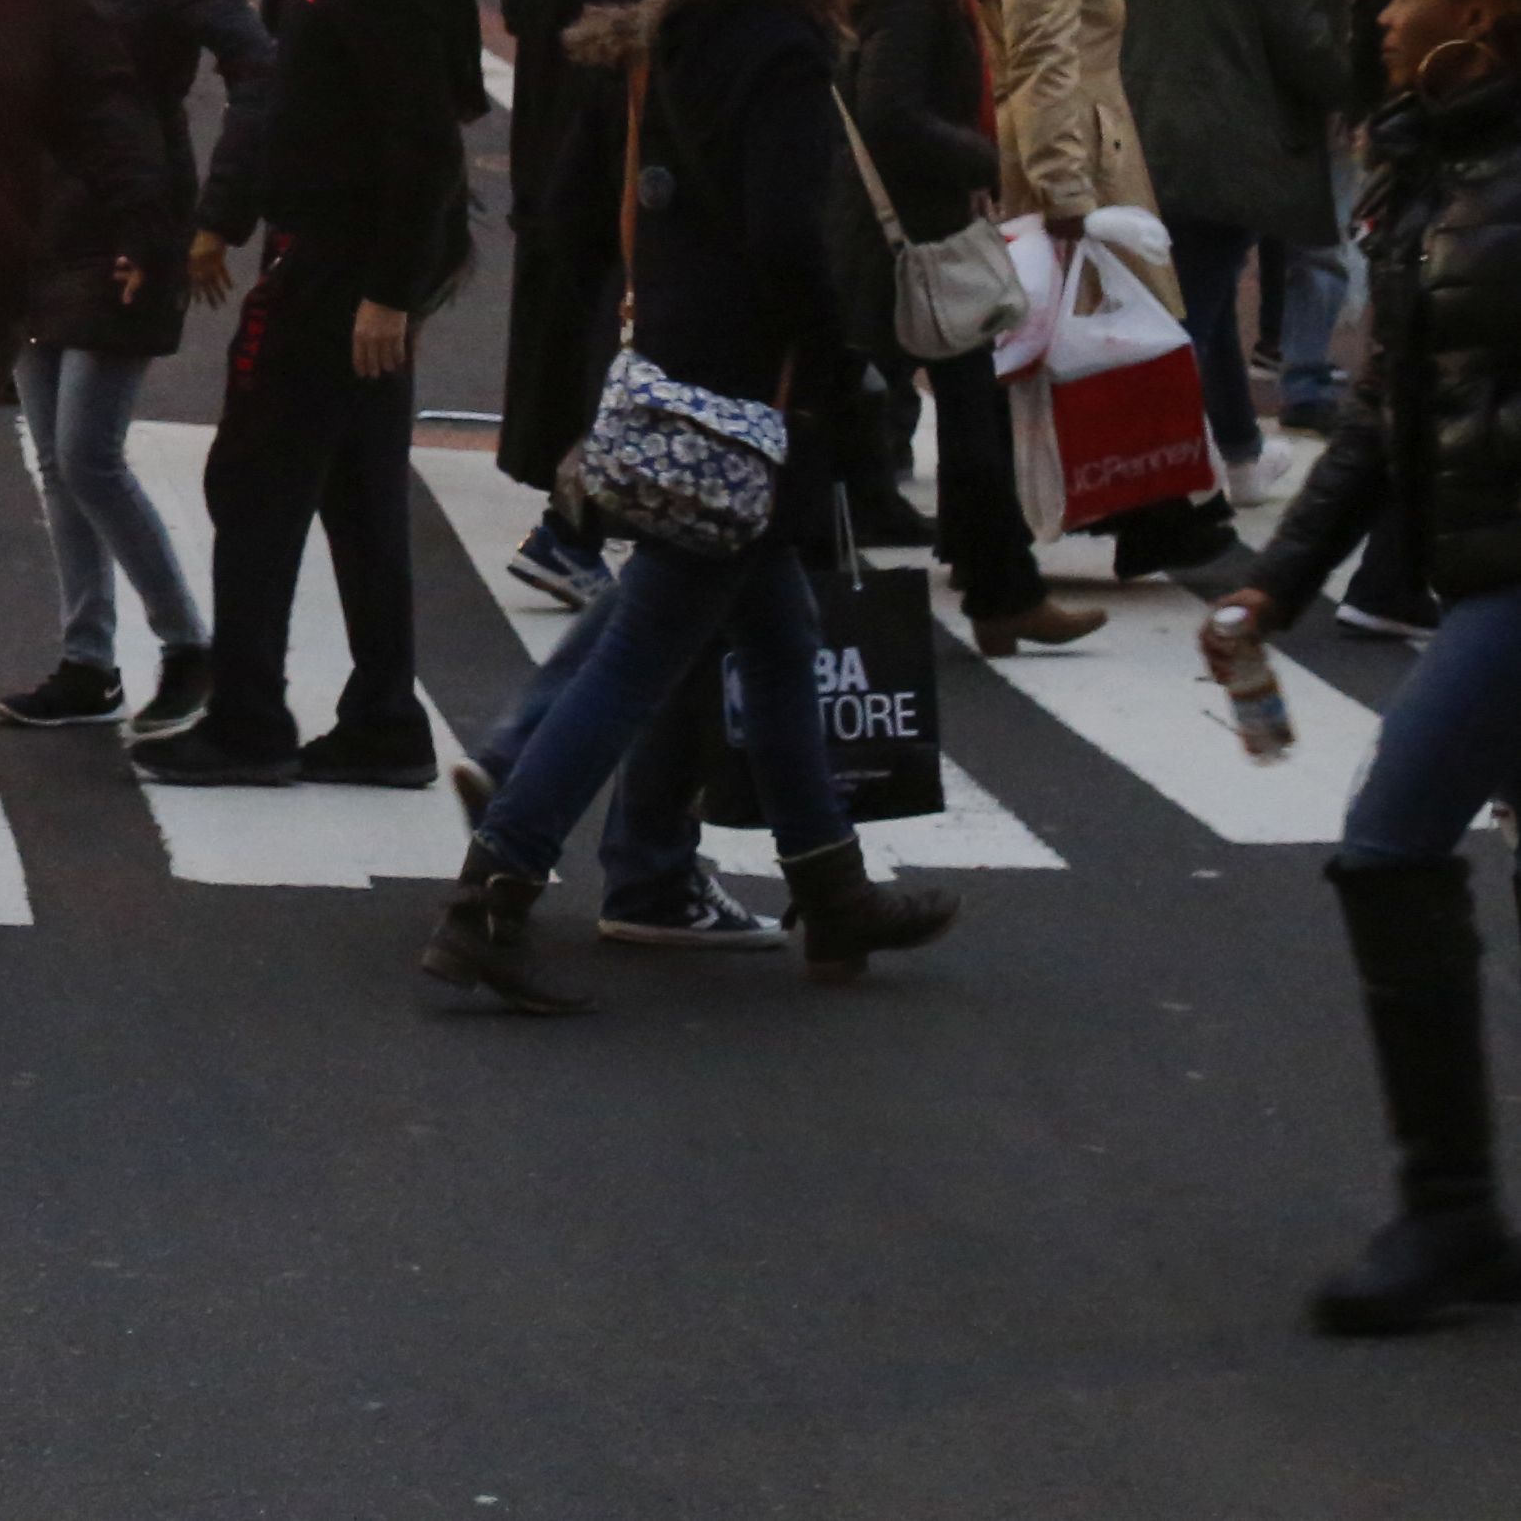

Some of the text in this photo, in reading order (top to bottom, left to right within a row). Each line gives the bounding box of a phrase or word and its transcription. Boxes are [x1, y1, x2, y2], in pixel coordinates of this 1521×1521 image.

[1071, 437, 1202, 494] JCPenney
[813, 647, 870, 695] BA
[818, 692, 919, 740] TORE
